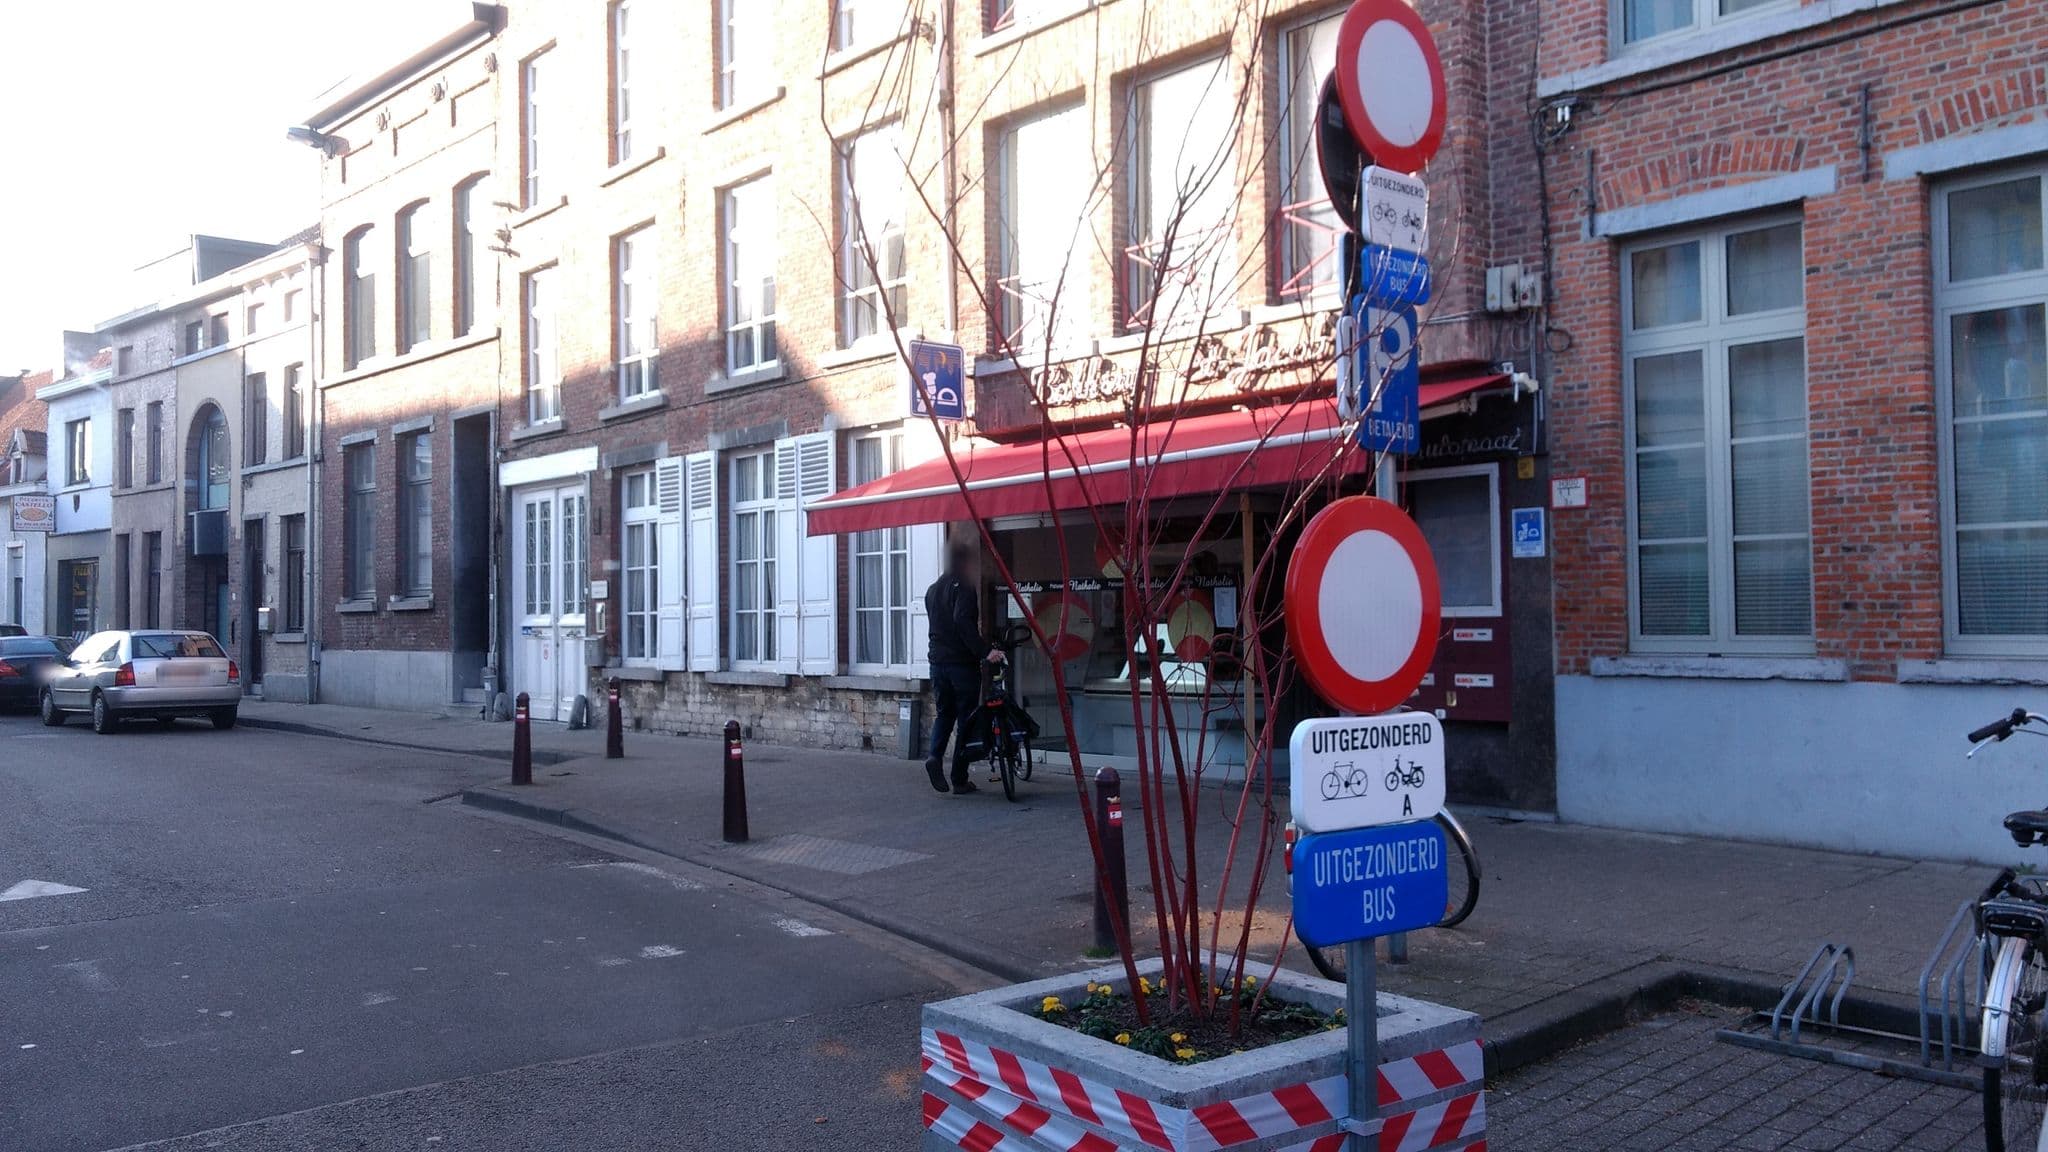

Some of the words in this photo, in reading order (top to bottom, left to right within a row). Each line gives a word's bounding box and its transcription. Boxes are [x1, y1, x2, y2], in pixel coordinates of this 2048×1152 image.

[1371, 175, 1425, 199] UITGEZONDERD
[1411, 232, 1417, 244] A
[1312, 722, 1432, 754] UITGEZONDERD
[1402, 793, 1413, 816] A
[1314, 837, 1439, 888] UITGEZONDERD
[1363, 885, 1396, 924] BUS
